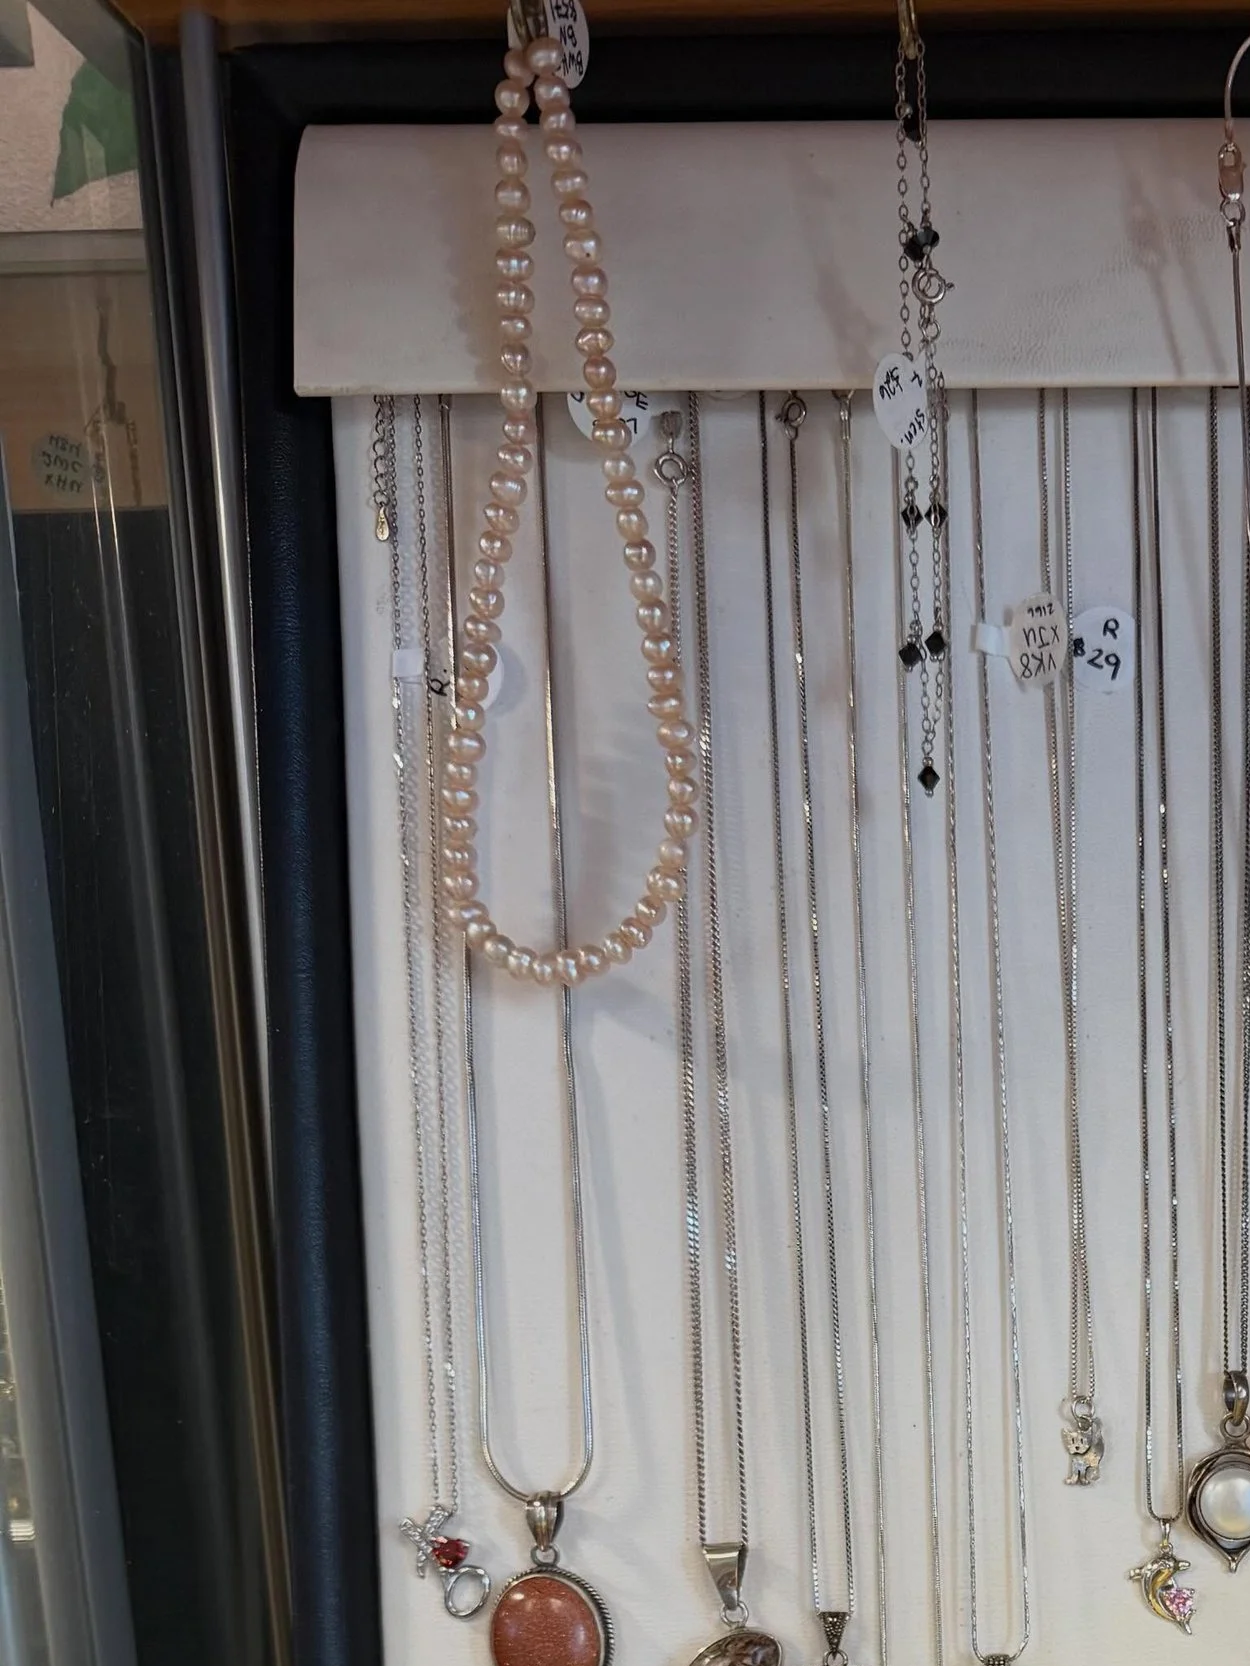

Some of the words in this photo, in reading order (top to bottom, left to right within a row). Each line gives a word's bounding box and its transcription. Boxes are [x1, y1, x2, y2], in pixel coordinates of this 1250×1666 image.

[1102, 617, 1120, 640] R
[1019, 652, 1057, 679] VK8
[1072, 637, 1121, 680] $29
